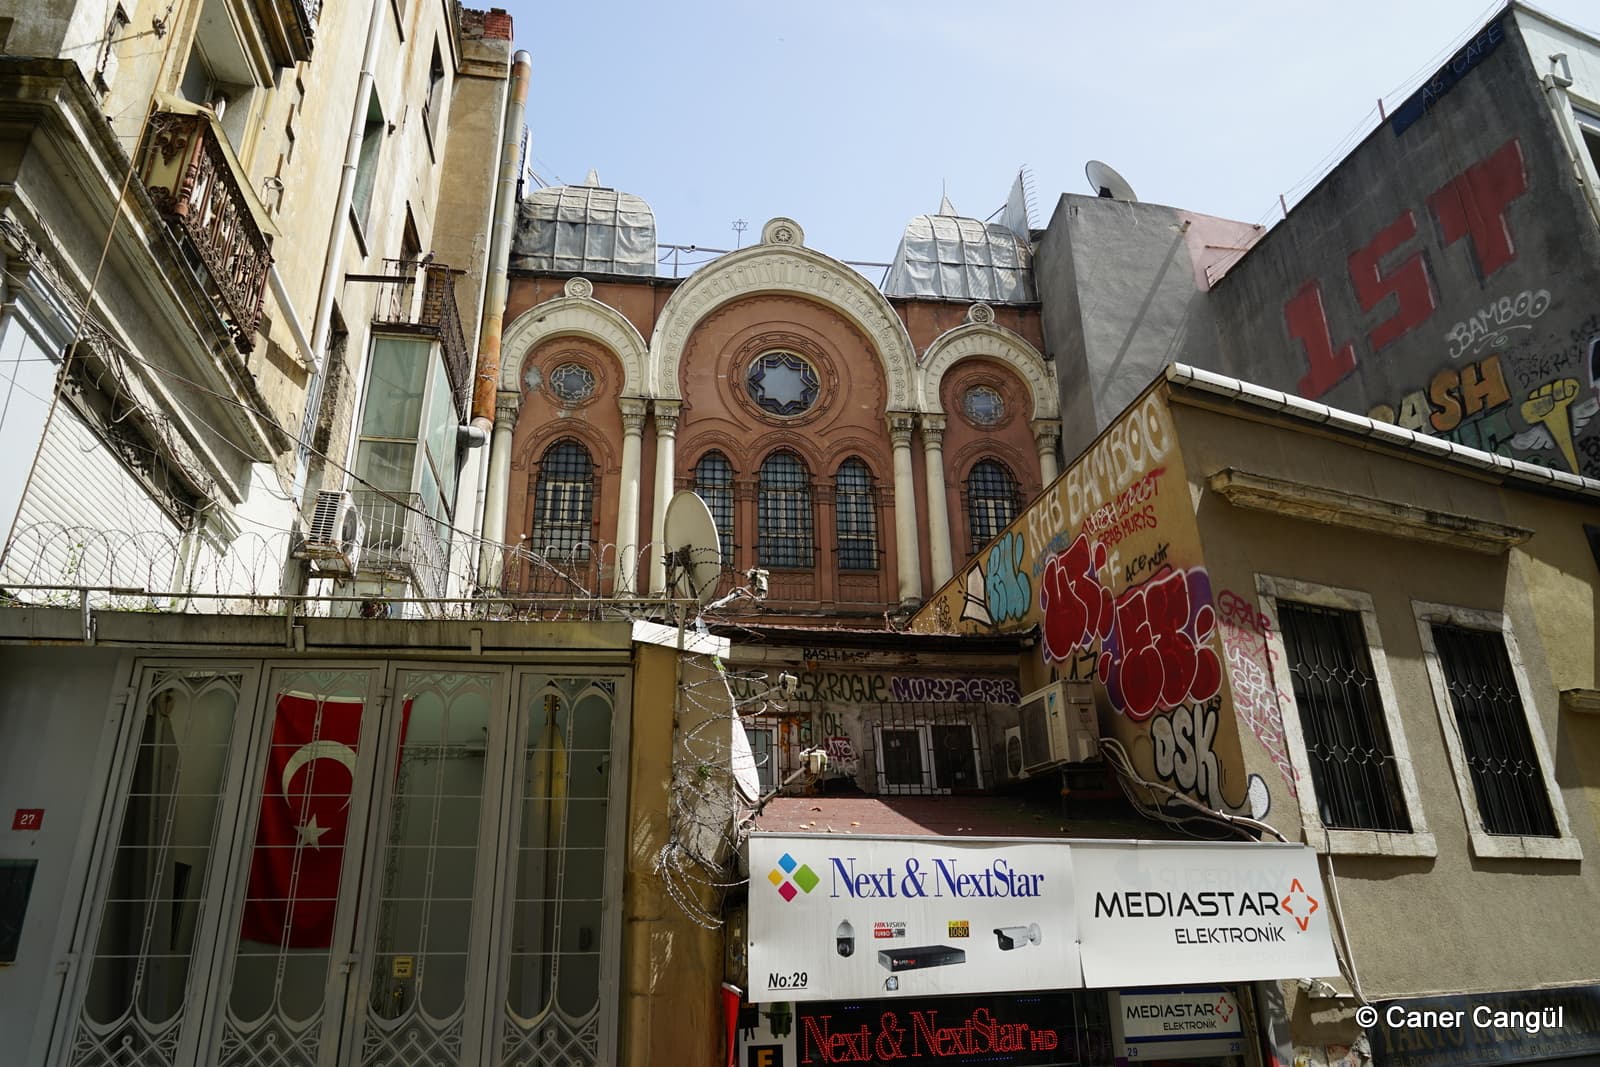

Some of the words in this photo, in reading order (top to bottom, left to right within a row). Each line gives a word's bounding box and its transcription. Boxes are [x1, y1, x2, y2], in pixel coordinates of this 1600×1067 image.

[1452, 22, 1502, 73] CAFE
[1444, 288, 1552, 359] BAMBOO
[1067, 392, 1171, 527] BAMBOO
[20, 814, 35, 825] 27
[828, 857, 898, 898] Next
[900, 857, 928, 898] &
[931, 857, 1046, 899] NextStar
[1095, 891, 1281, 918] MEDIASTAR
[949, 927, 968, 937] 1080
[1175, 922, 1286, 944] ELEKTRONİK
[768, 972, 808, 989] No:29
[1127, 1003, 1216, 1019] MEDIASTAR
[799, 1014, 874, 1064] Next
[874, 1010, 907, 1060] &
[908, 1006, 1029, 1057] NextStar
[1030, 1028, 1059, 1051] HD
[1127, 1047, 1138, 1057] 29
